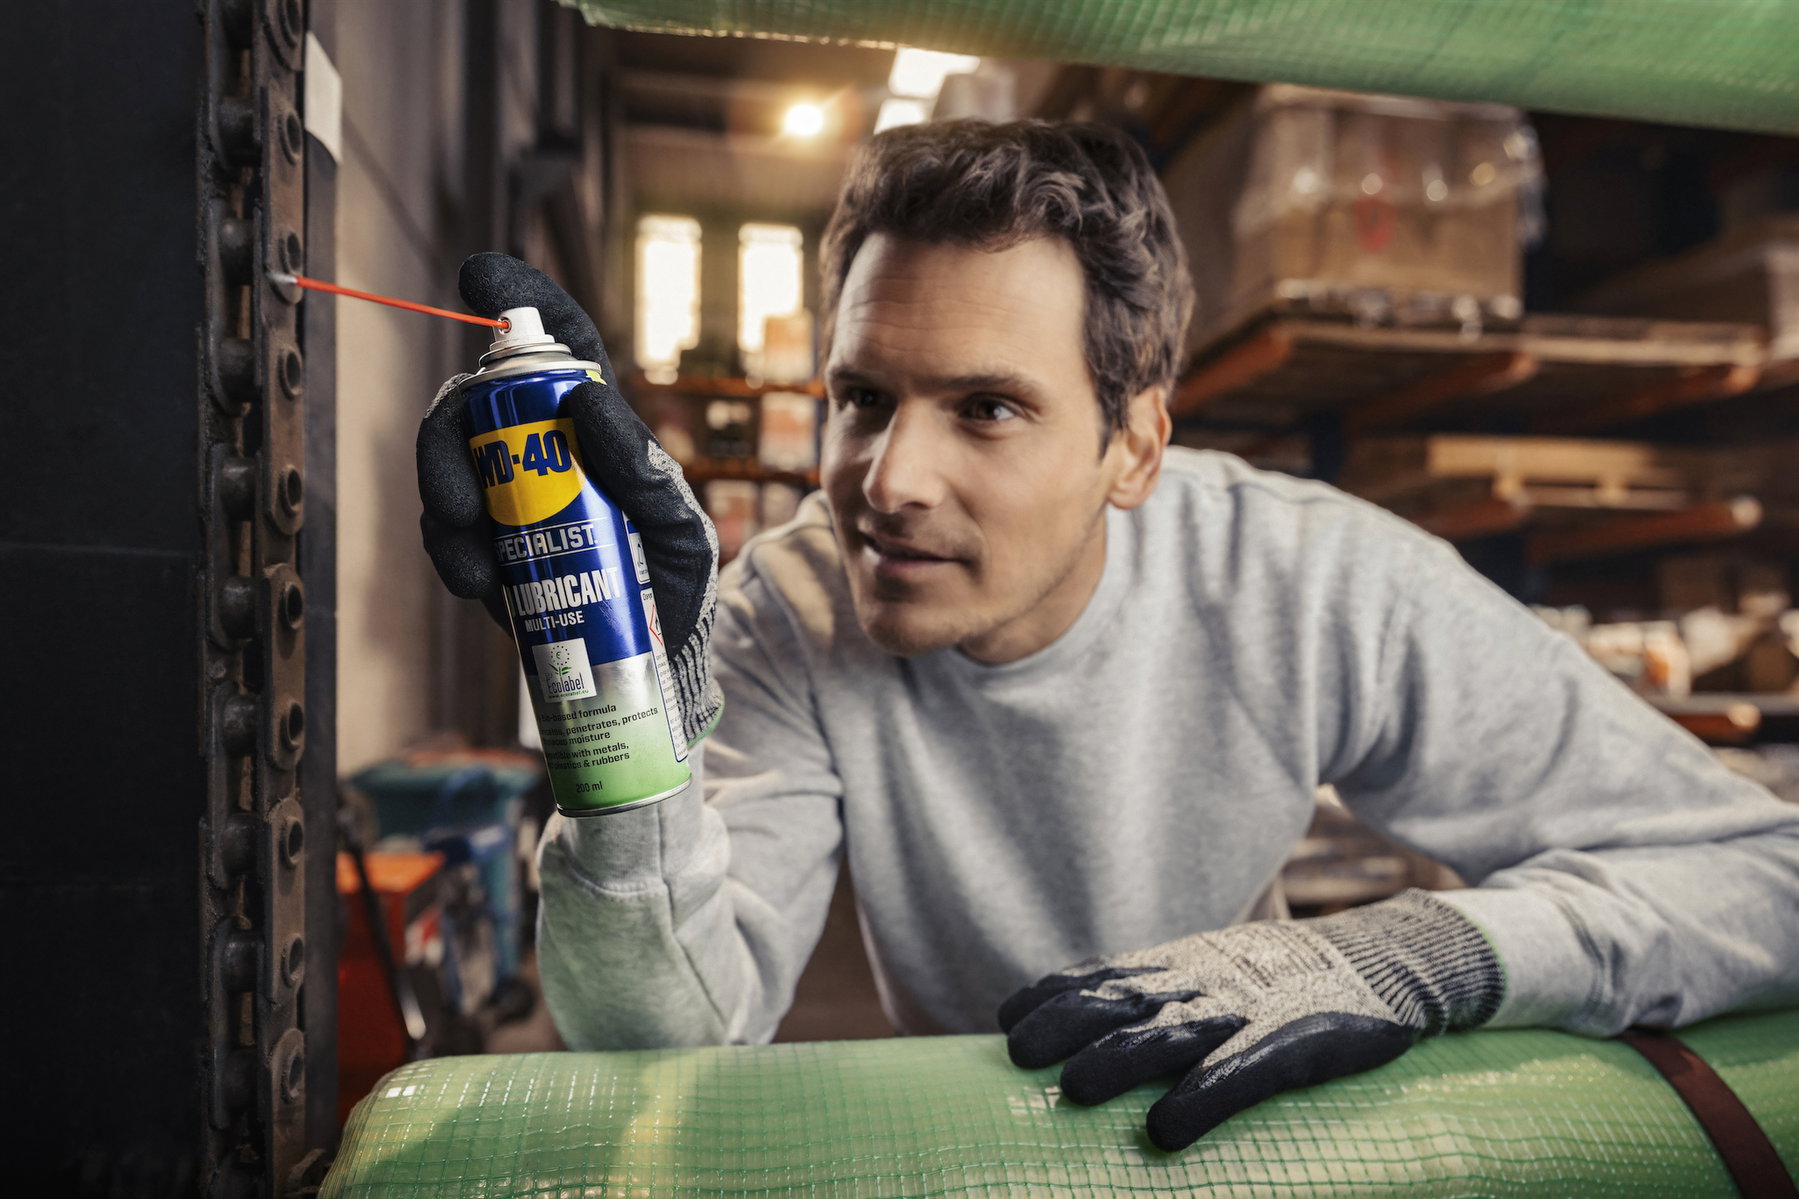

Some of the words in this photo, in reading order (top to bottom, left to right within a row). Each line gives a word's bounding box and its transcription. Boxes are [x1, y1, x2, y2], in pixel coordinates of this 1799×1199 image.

[473, 430, 572, 489] WD-40
[513, 567, 620, 617] LUBRICANT
[525, 611, 585, 633] MULTI-USE
[546, 672, 584, 694] Ecolabel
[566, 719, 621, 736] penetrates,
[621, 707, 658, 725] protects
[578, 705, 617, 719] formula
[568, 732, 611, 745] moisture
[571, 749, 591, 759] with
[592, 742, 629, 756] metals,
[583, 759, 590, 768] &
[591, 752, 630, 766] rubbers
[575, 782, 590, 793] 200
[591, 780, 603, 791] ml
